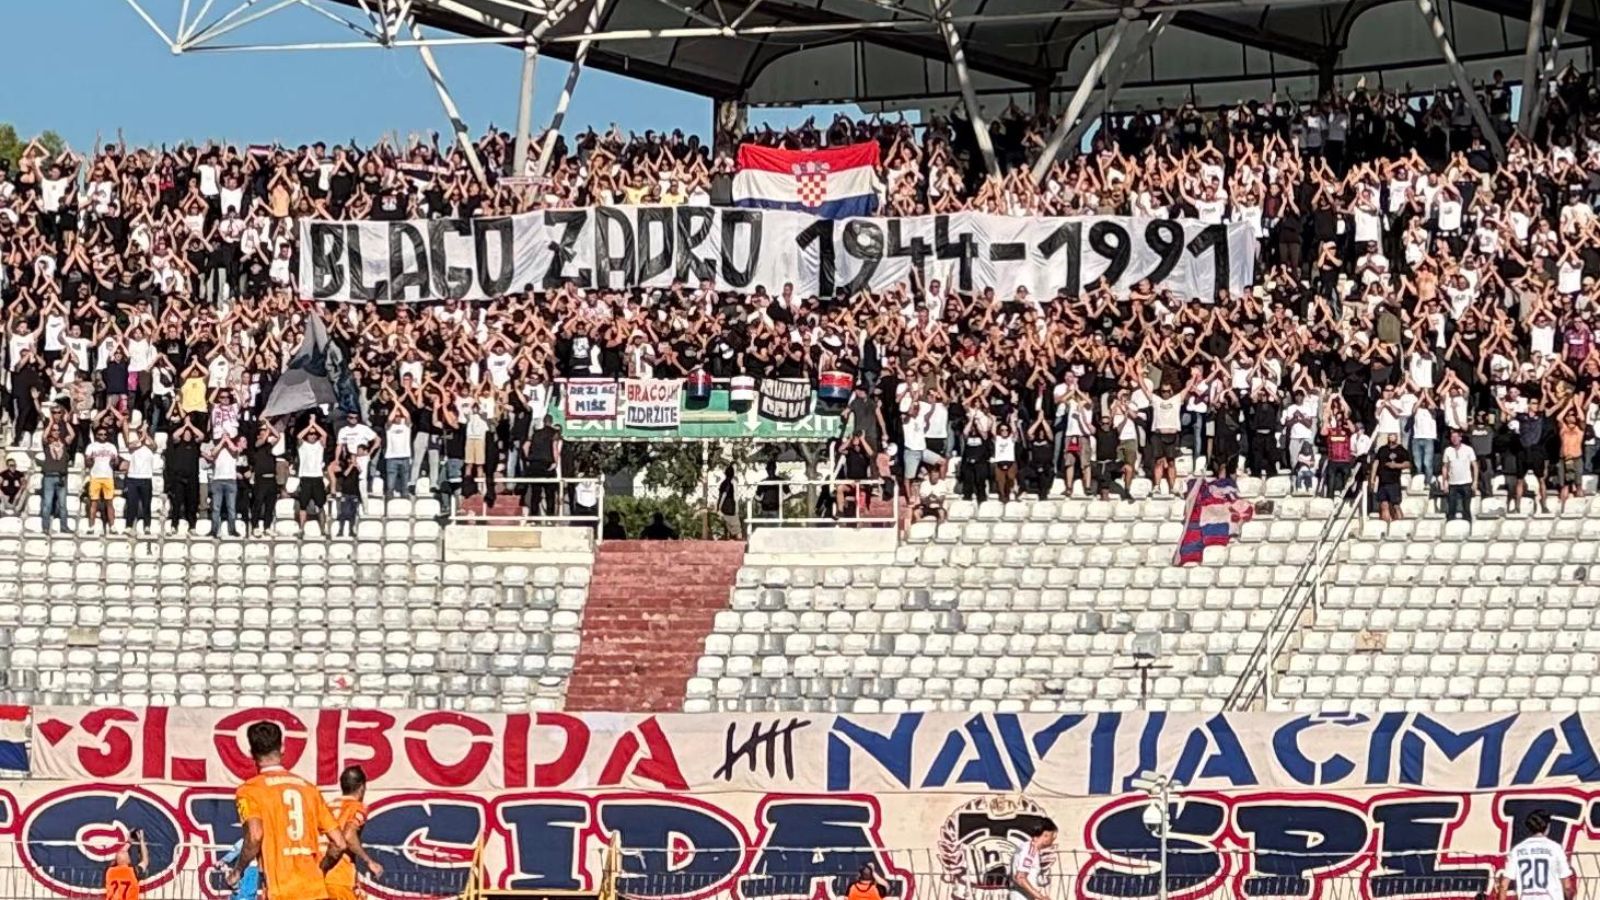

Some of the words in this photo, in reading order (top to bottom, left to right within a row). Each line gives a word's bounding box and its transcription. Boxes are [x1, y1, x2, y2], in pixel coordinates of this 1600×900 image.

[310, 216, 515, 301] BLAGO
[542, 206, 763, 289] ZADRO
[776, 415, 839, 431] EXIT
[78, 706, 690, 790] SLOBODA
[827, 710, 1600, 795] NAVIJAČIMA
[282, 788, 305, 841] 3
[1518, 858, 1549, 890] 20
